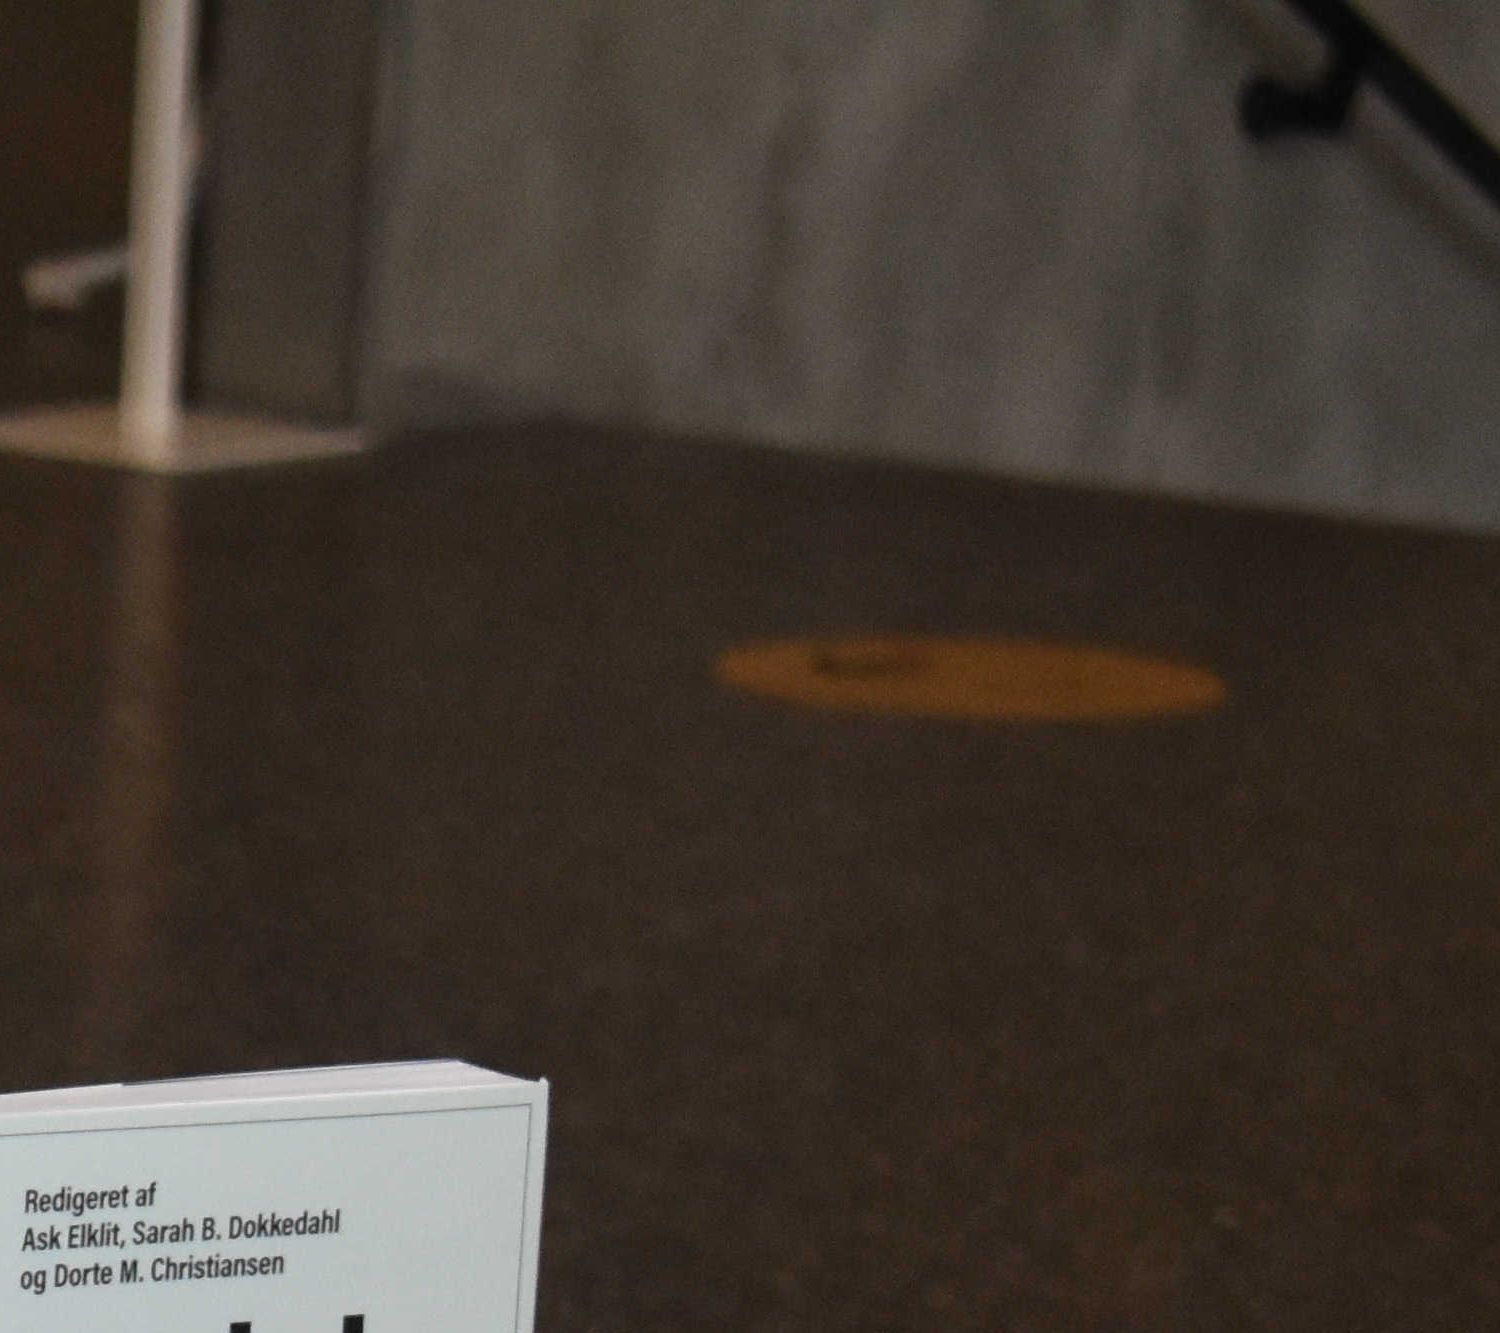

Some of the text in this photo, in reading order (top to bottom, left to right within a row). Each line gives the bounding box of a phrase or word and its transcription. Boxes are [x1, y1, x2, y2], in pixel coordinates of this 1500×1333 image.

[24, 1182, 158, 1217] Redigeret af
[21, 1208, 342, 1252] Ask Elklit, Sarah B. Dokkedahl
[20, 1254, 285, 1295] og Dorte M. Christiansen
